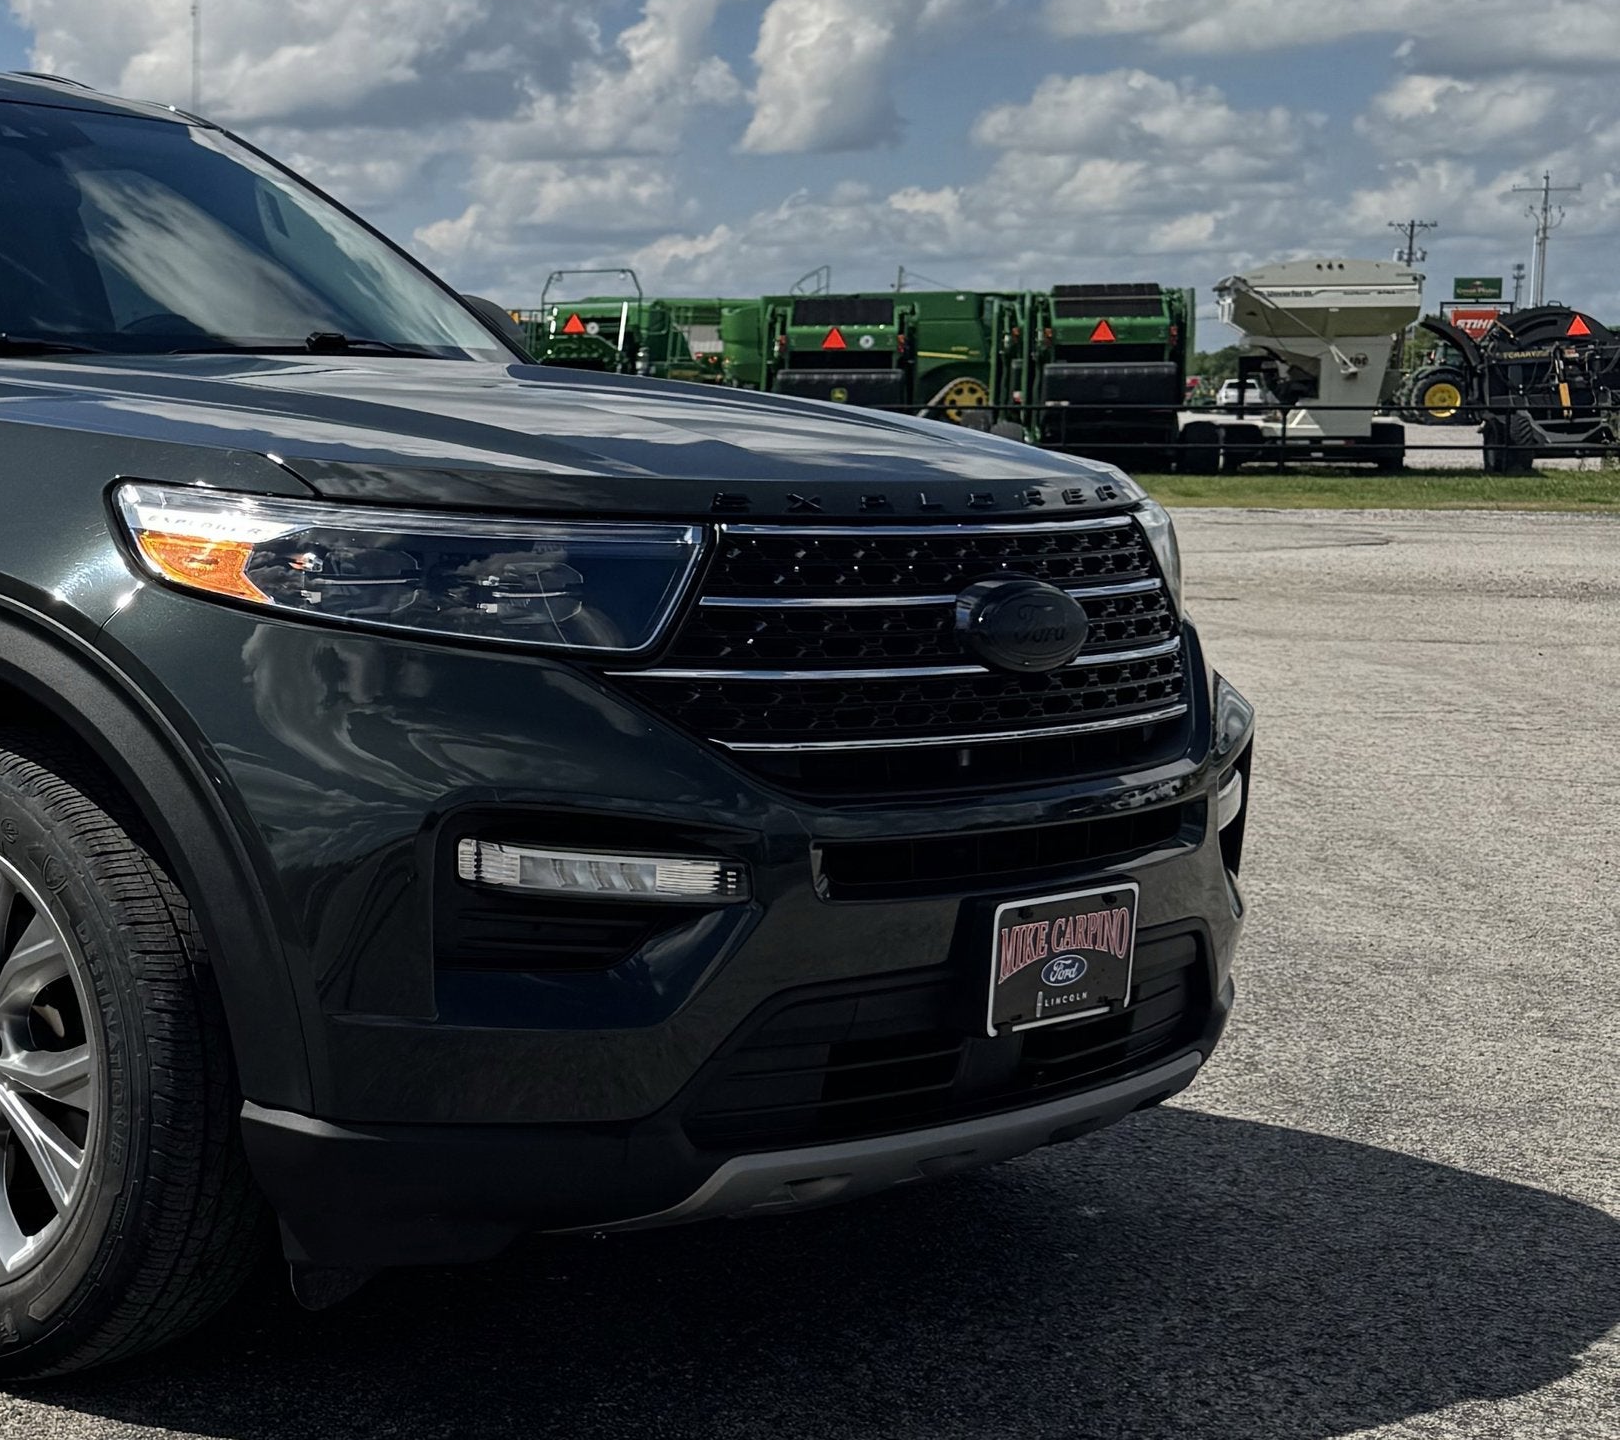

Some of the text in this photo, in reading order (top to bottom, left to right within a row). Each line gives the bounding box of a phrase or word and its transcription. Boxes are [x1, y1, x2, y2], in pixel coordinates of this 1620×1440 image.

[710, 485, 1119, 513] EXPLORER
[998, 907, 1129, 985] MIKE CARPINO
[1049, 959, 1079, 982] Ford
[1044, 992, 1088, 1007] LINCOLN
